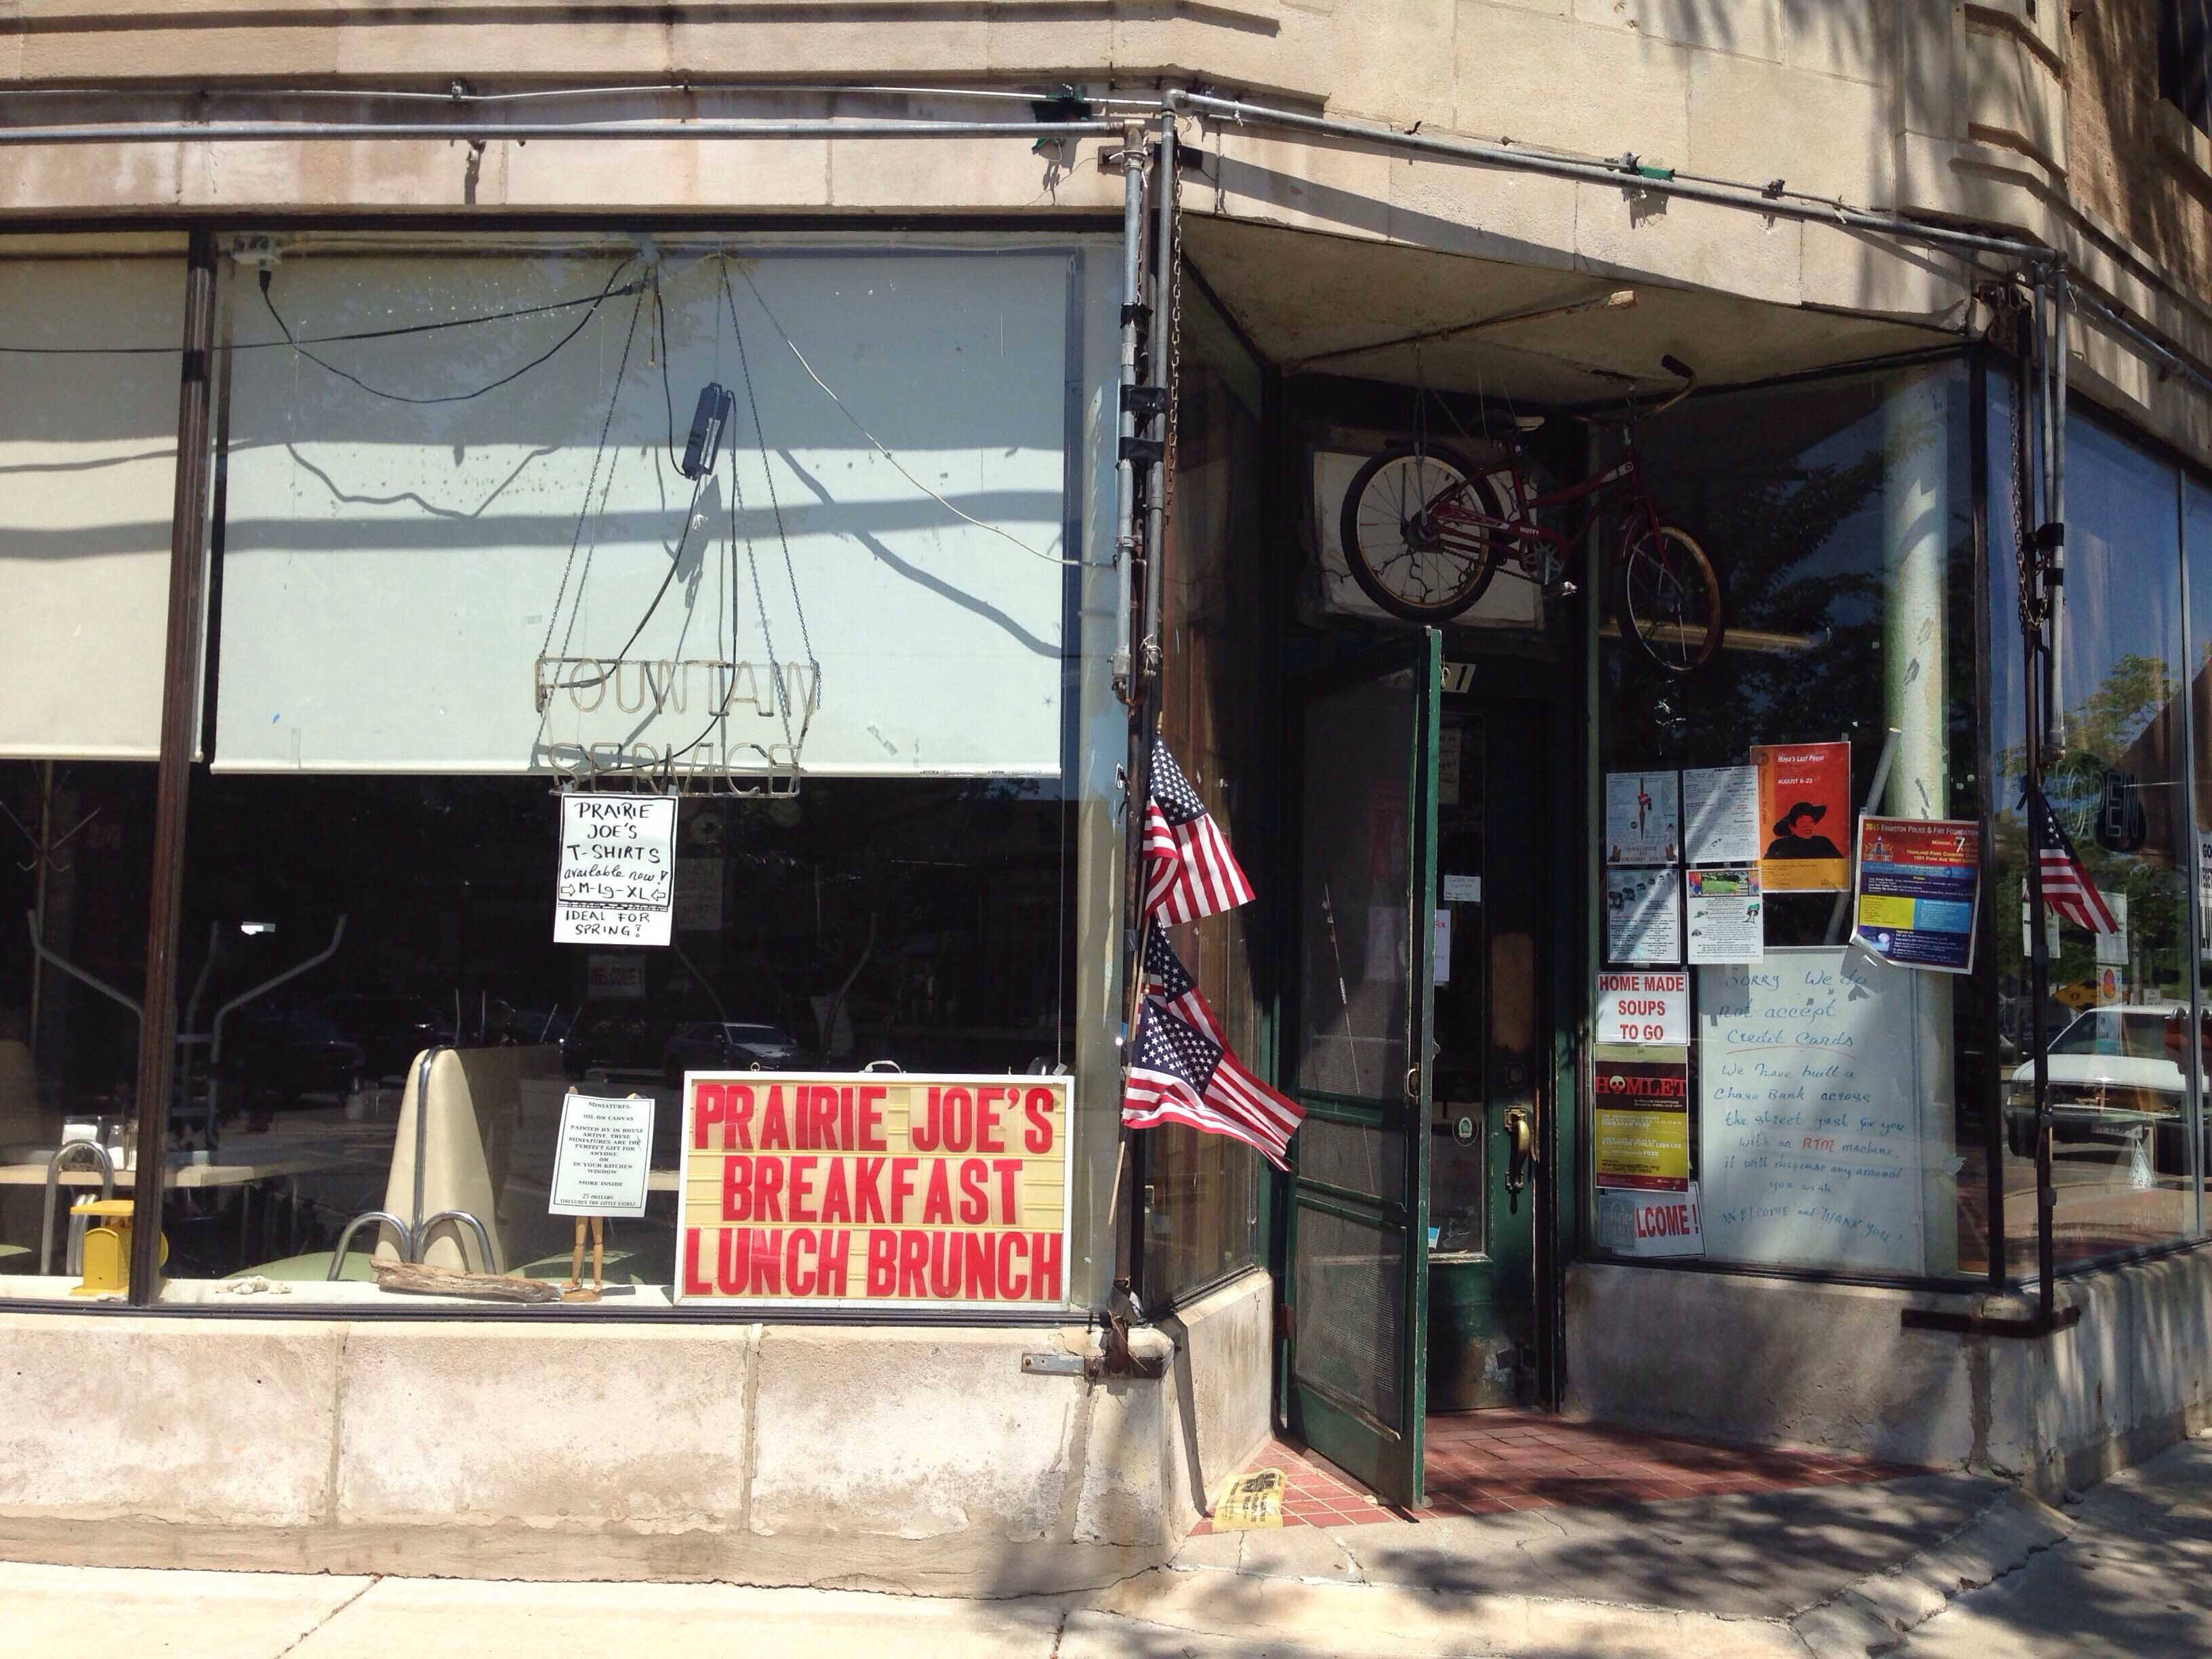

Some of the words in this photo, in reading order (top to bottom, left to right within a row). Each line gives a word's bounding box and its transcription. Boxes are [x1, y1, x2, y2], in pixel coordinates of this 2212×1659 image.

[573, 802, 654, 820] PRAIRIE
[587, 822, 637, 839] JOE'S
[567, 844, 661, 863] T-SHIRTS
[564, 863, 624, 879] available
[566, 910, 605, 922] IDEAL
[618, 912, 650, 922] FOR
[1599, 976, 1639, 991] HOME
[1644, 976, 1684, 991] MADE
[1840, 968, 1866, 985] do
[1618, 1000, 1665, 1016] SOUPS
[1765, 999, 1837, 1023] accept
[1620, 1024, 1639, 1040] TO
[1643, 1024, 1664, 1040] GO
[1727, 1029, 1785, 1044] Credit
[1796, 1031, 1853, 1047] Cards
[1722, 1063, 1744, 1076] We
[1595, 1076, 1686, 1097] HMLET
[1768, 1086, 1805, 1101] Bank
[693, 1084, 888, 1152] PRAIRIE
[912, 1086, 1054, 1155] JOE'S
[1725, 1109, 1747, 1126] the
[1801, 1137, 1835, 1152] ATM
[722, 1155, 1023, 1225] BREAKFAST
[1635, 1204, 1699, 1238] LCOME!
[684, 1227, 851, 1296] LUNCH
[866, 1229, 1063, 1300] BRUNCH
